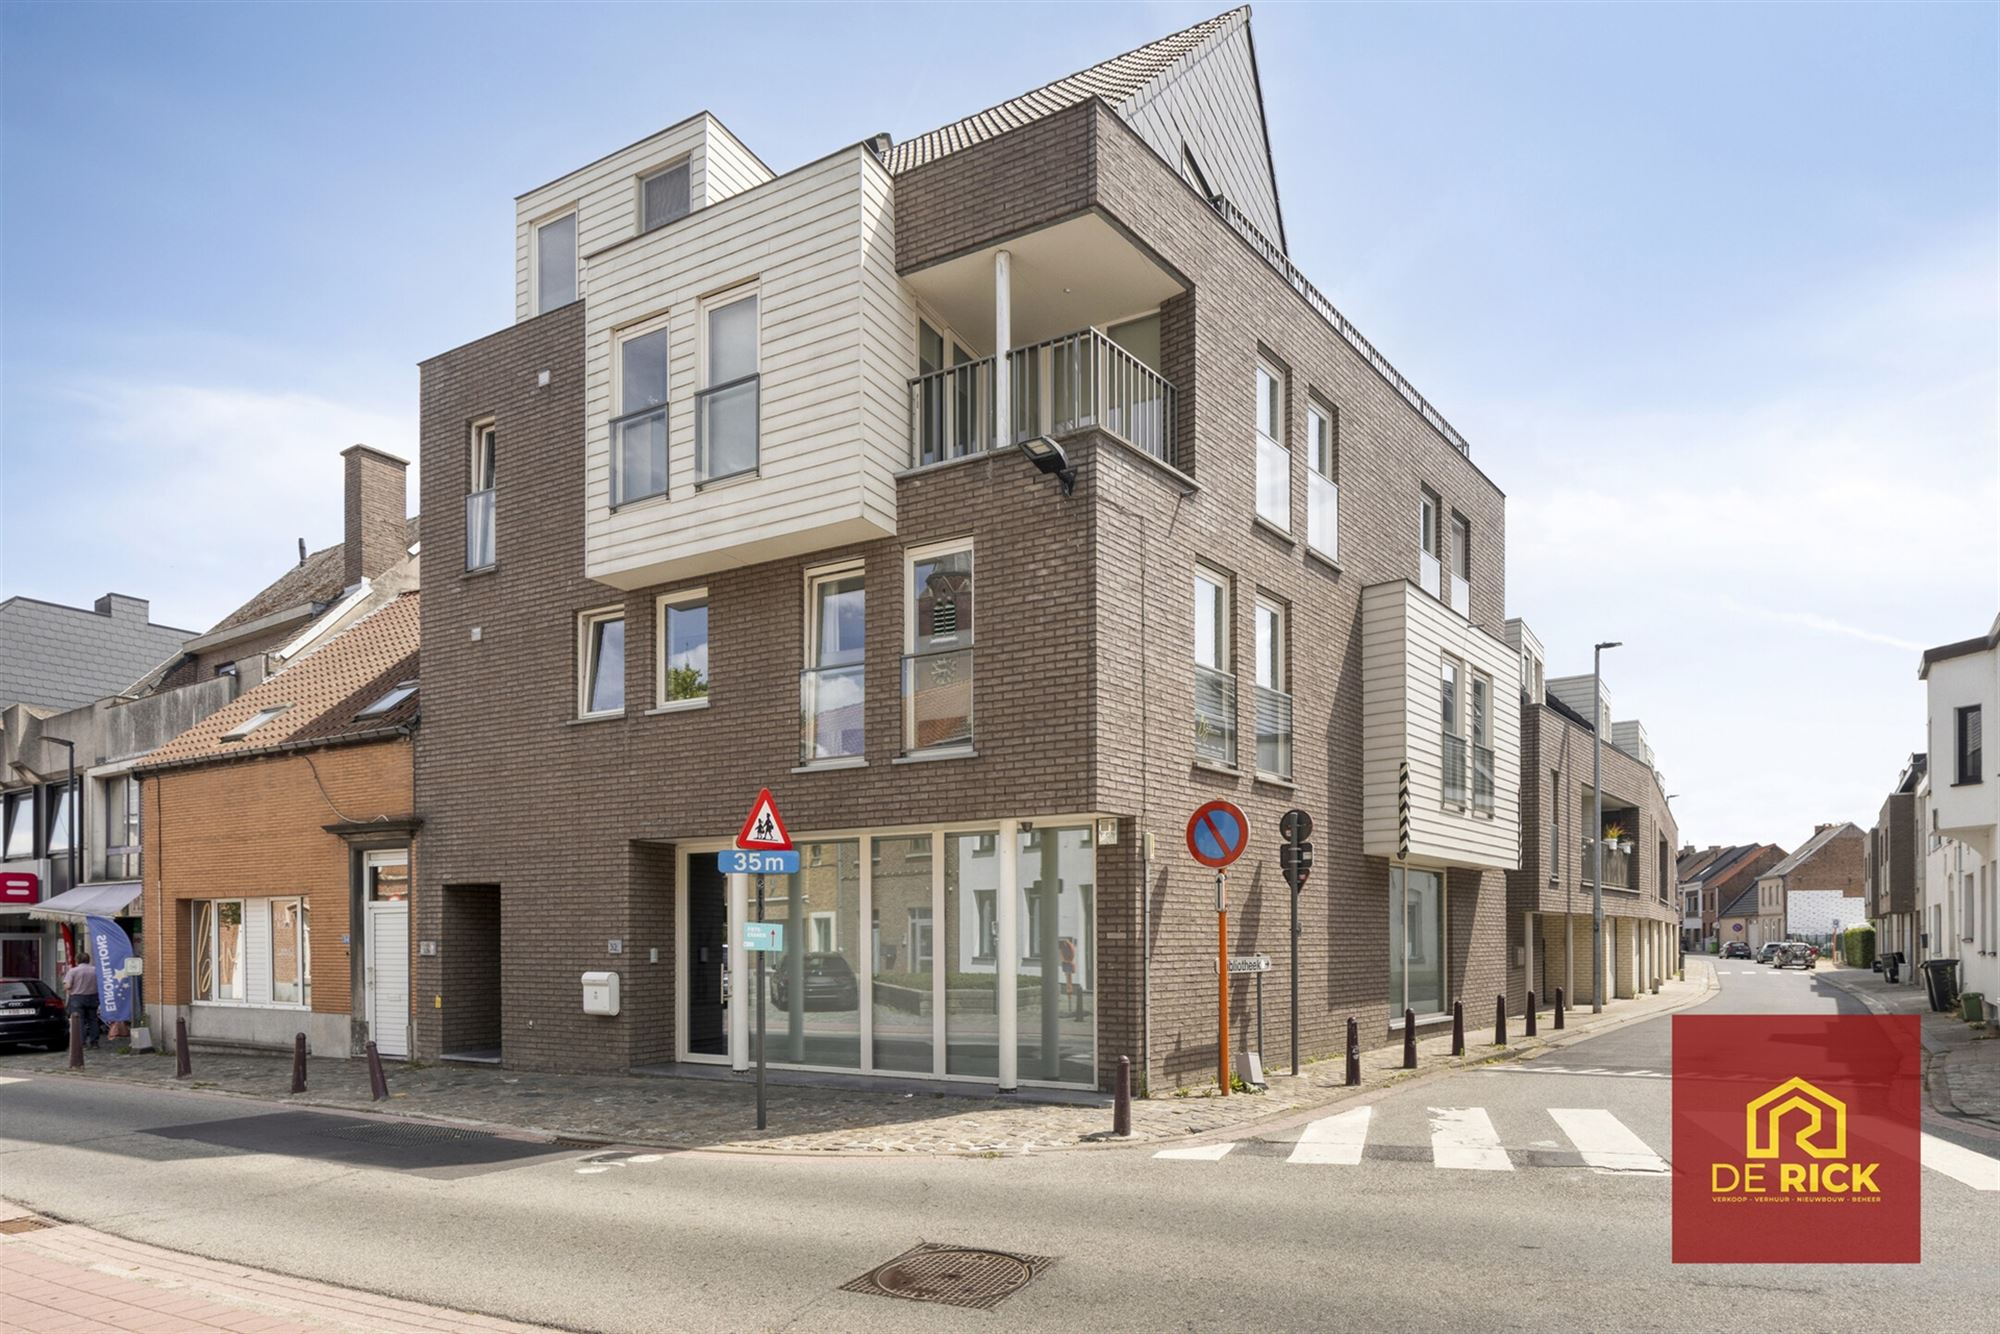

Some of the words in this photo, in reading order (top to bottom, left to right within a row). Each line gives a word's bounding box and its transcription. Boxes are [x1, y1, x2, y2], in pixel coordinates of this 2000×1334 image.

[734, 852, 762, 871] 35
[765, 857, 784, 871] m
[1228, 959, 1262, 972] bliotheek
